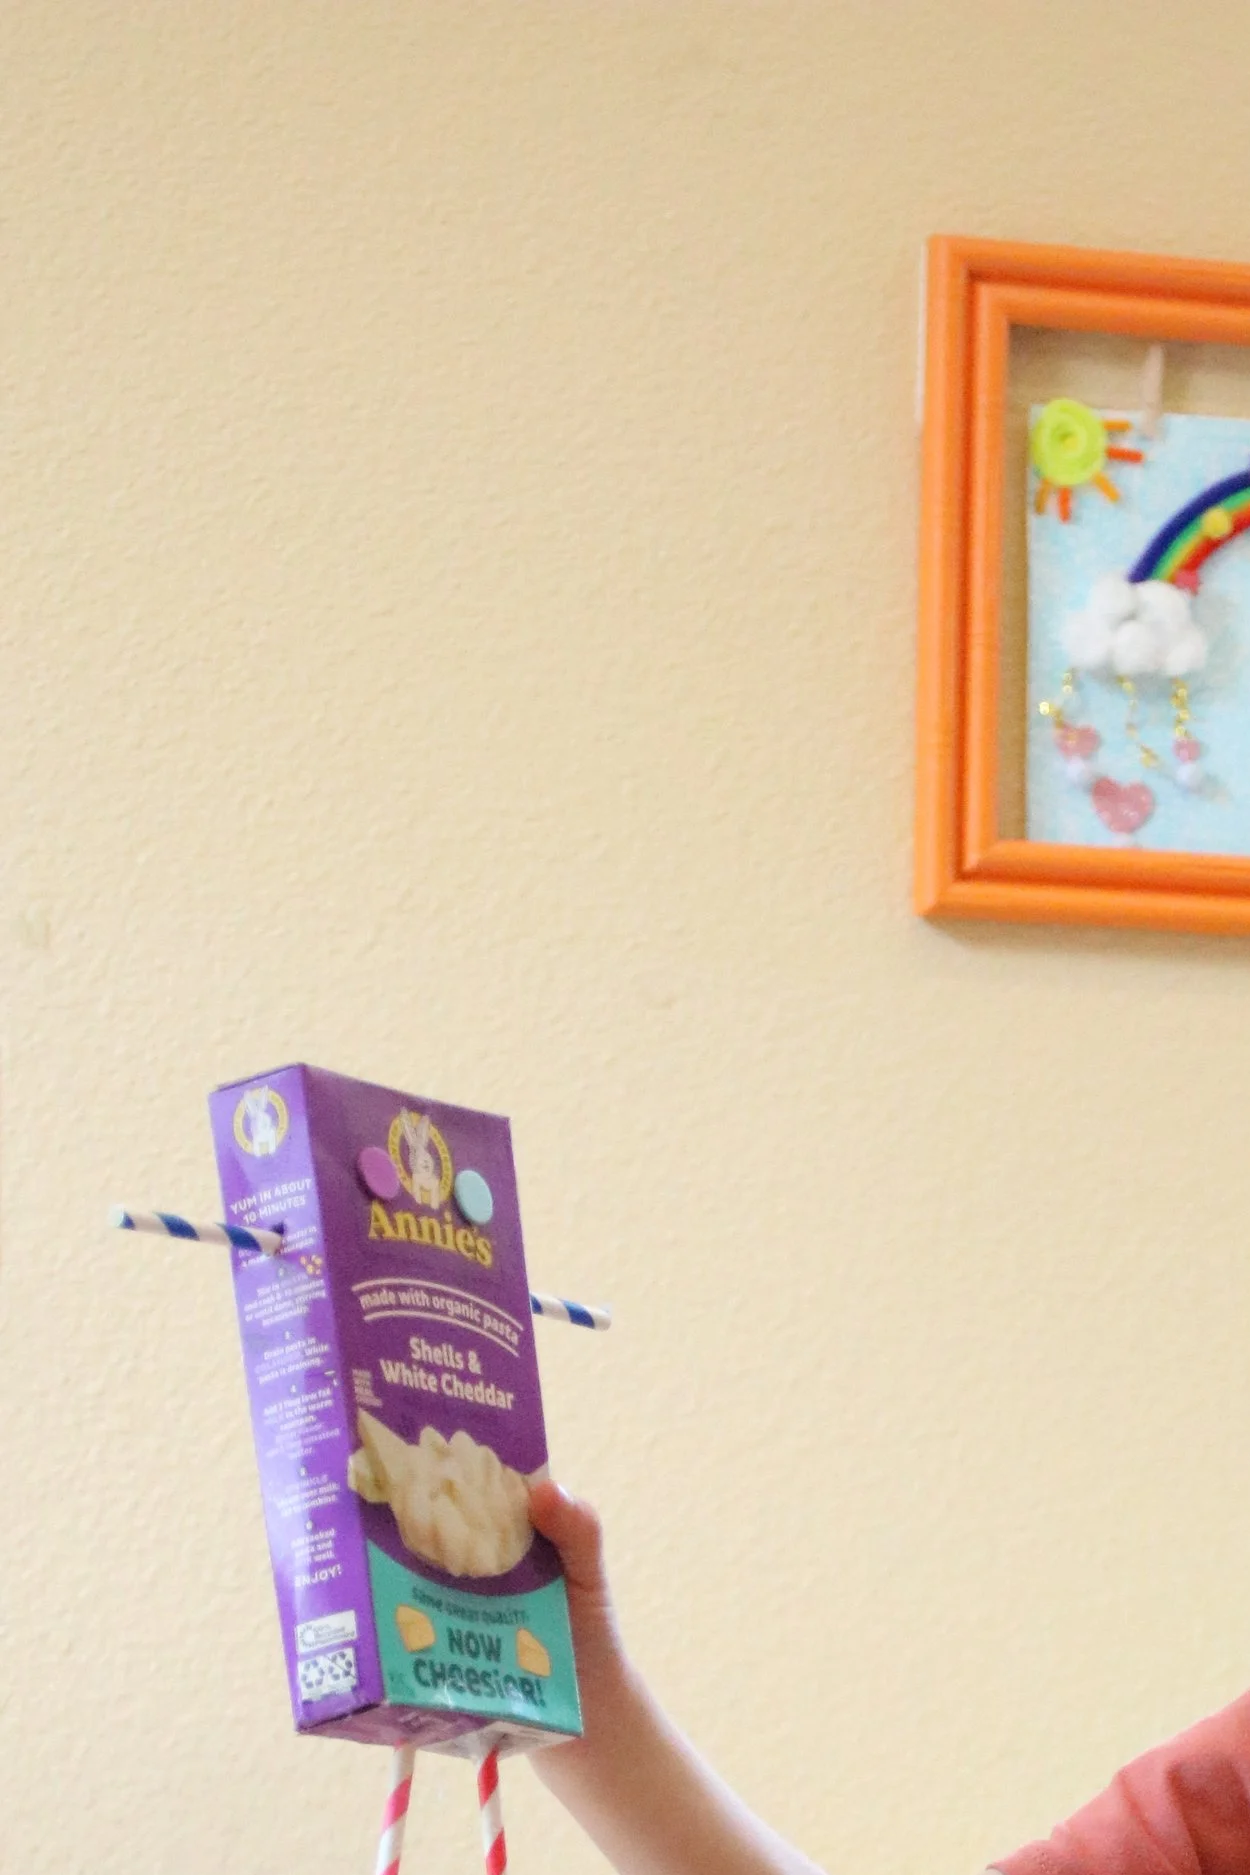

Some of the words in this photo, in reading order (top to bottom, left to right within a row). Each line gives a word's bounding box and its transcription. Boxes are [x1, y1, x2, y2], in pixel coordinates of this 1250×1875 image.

[230, 1195, 257, 1215] YUM
[259, 1190, 272, 1204] IN
[274, 1178, 313, 1197] ABOUT
[242, 1212, 256, 1225] 10
[258, 1194, 307, 1218] MINUTES
[359, 1290, 396, 1311] made
[399, 1286, 431, 1307] with
[432, 1296, 481, 1322] organic
[483, 1313, 520, 1345] pasta
[409, 1335, 465, 1370] Shells
[467, 1350, 482, 1375] &
[379, 1357, 438, 1393] White
[441, 1372, 515, 1410] Cheddar
[295, 1563, 342, 1588] ENJOY!
[447, 1626, 502, 1663] NOW
